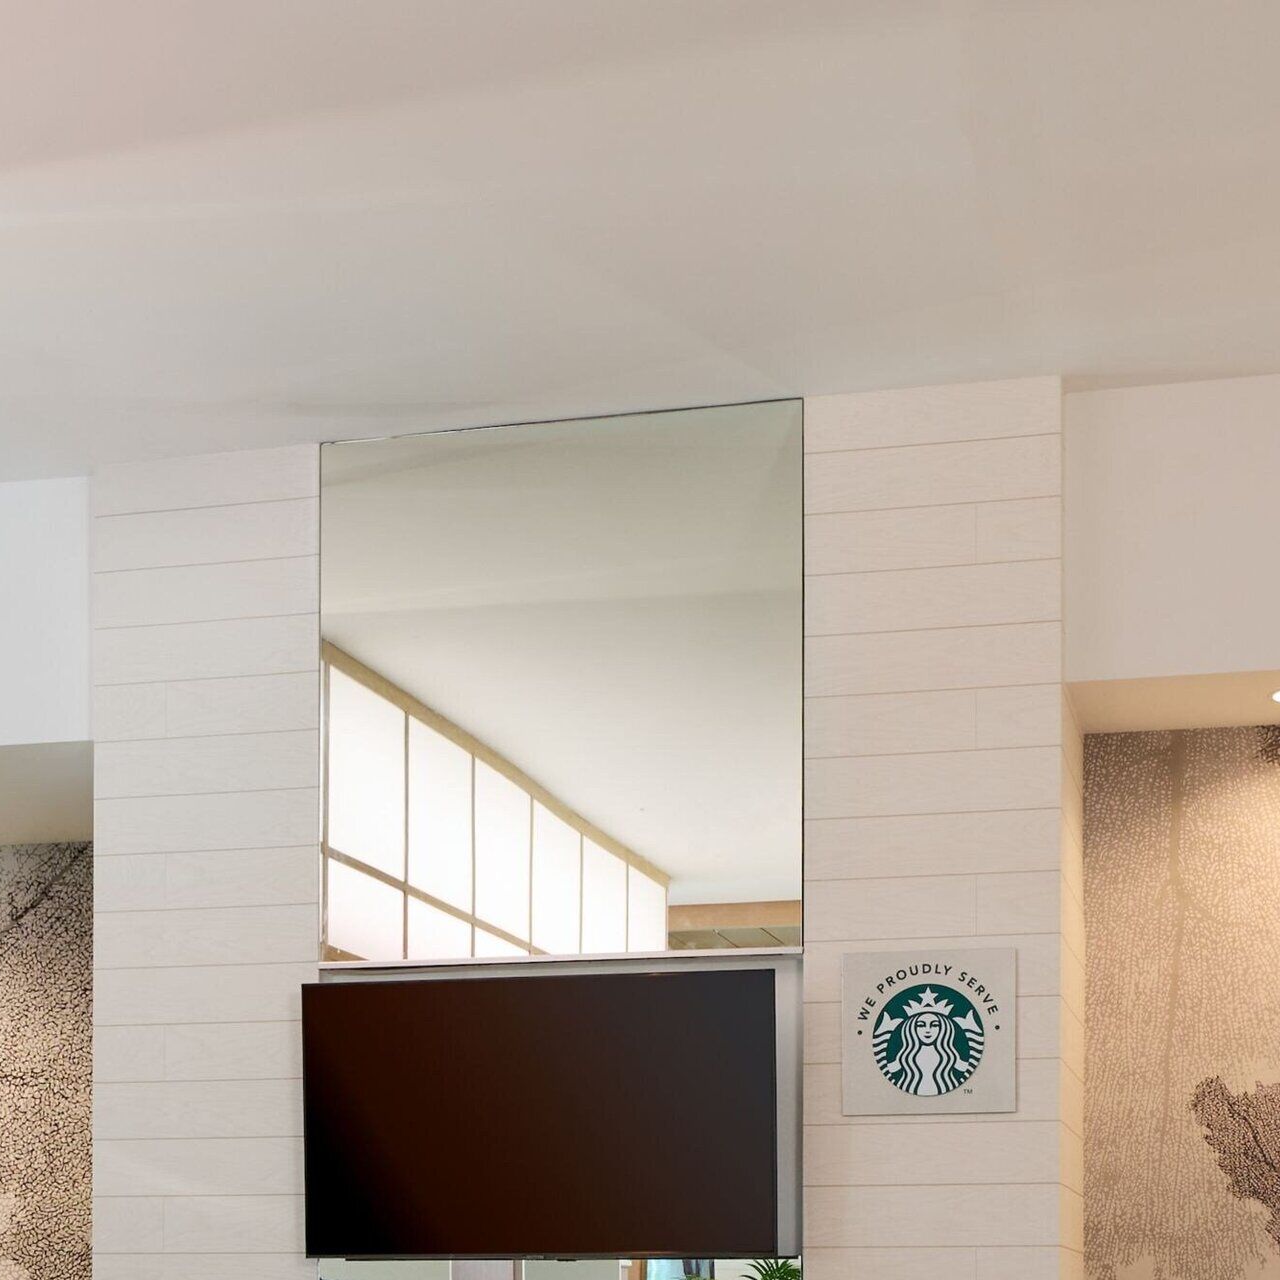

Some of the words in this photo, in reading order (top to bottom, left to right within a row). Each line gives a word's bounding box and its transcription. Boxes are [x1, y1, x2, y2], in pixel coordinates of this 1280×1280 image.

[857, 997, 877, 1022] WE
[876, 963, 953, 994] PROUDLY
[958, 971, 999, 1015] SERVE
